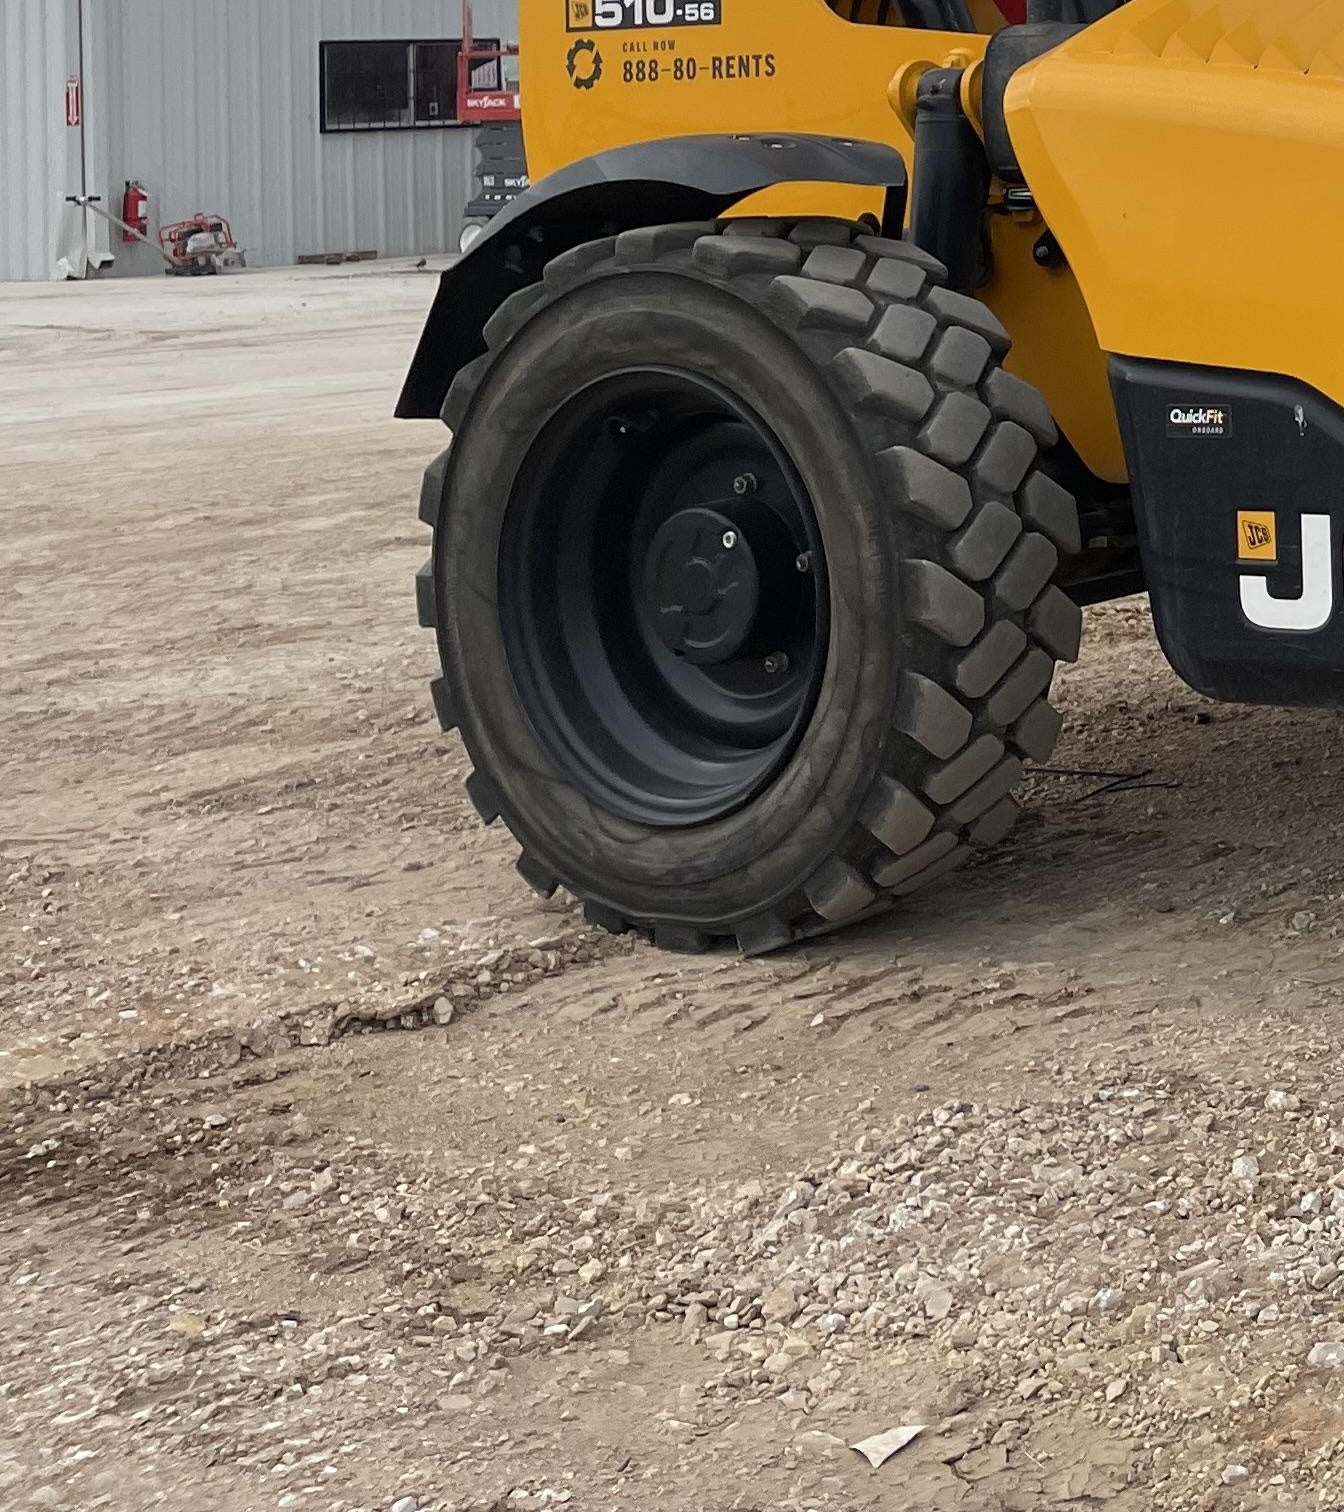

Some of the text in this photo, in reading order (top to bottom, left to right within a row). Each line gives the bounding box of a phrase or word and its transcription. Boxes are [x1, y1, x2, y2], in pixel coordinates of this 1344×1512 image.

[622, 39, 676, 53] CALL NOW
[622, 54, 776, 83] 888-80-RENTS
[1170, 408, 1224, 424] QuickFit
[1247, 524, 1269, 546] JCB
